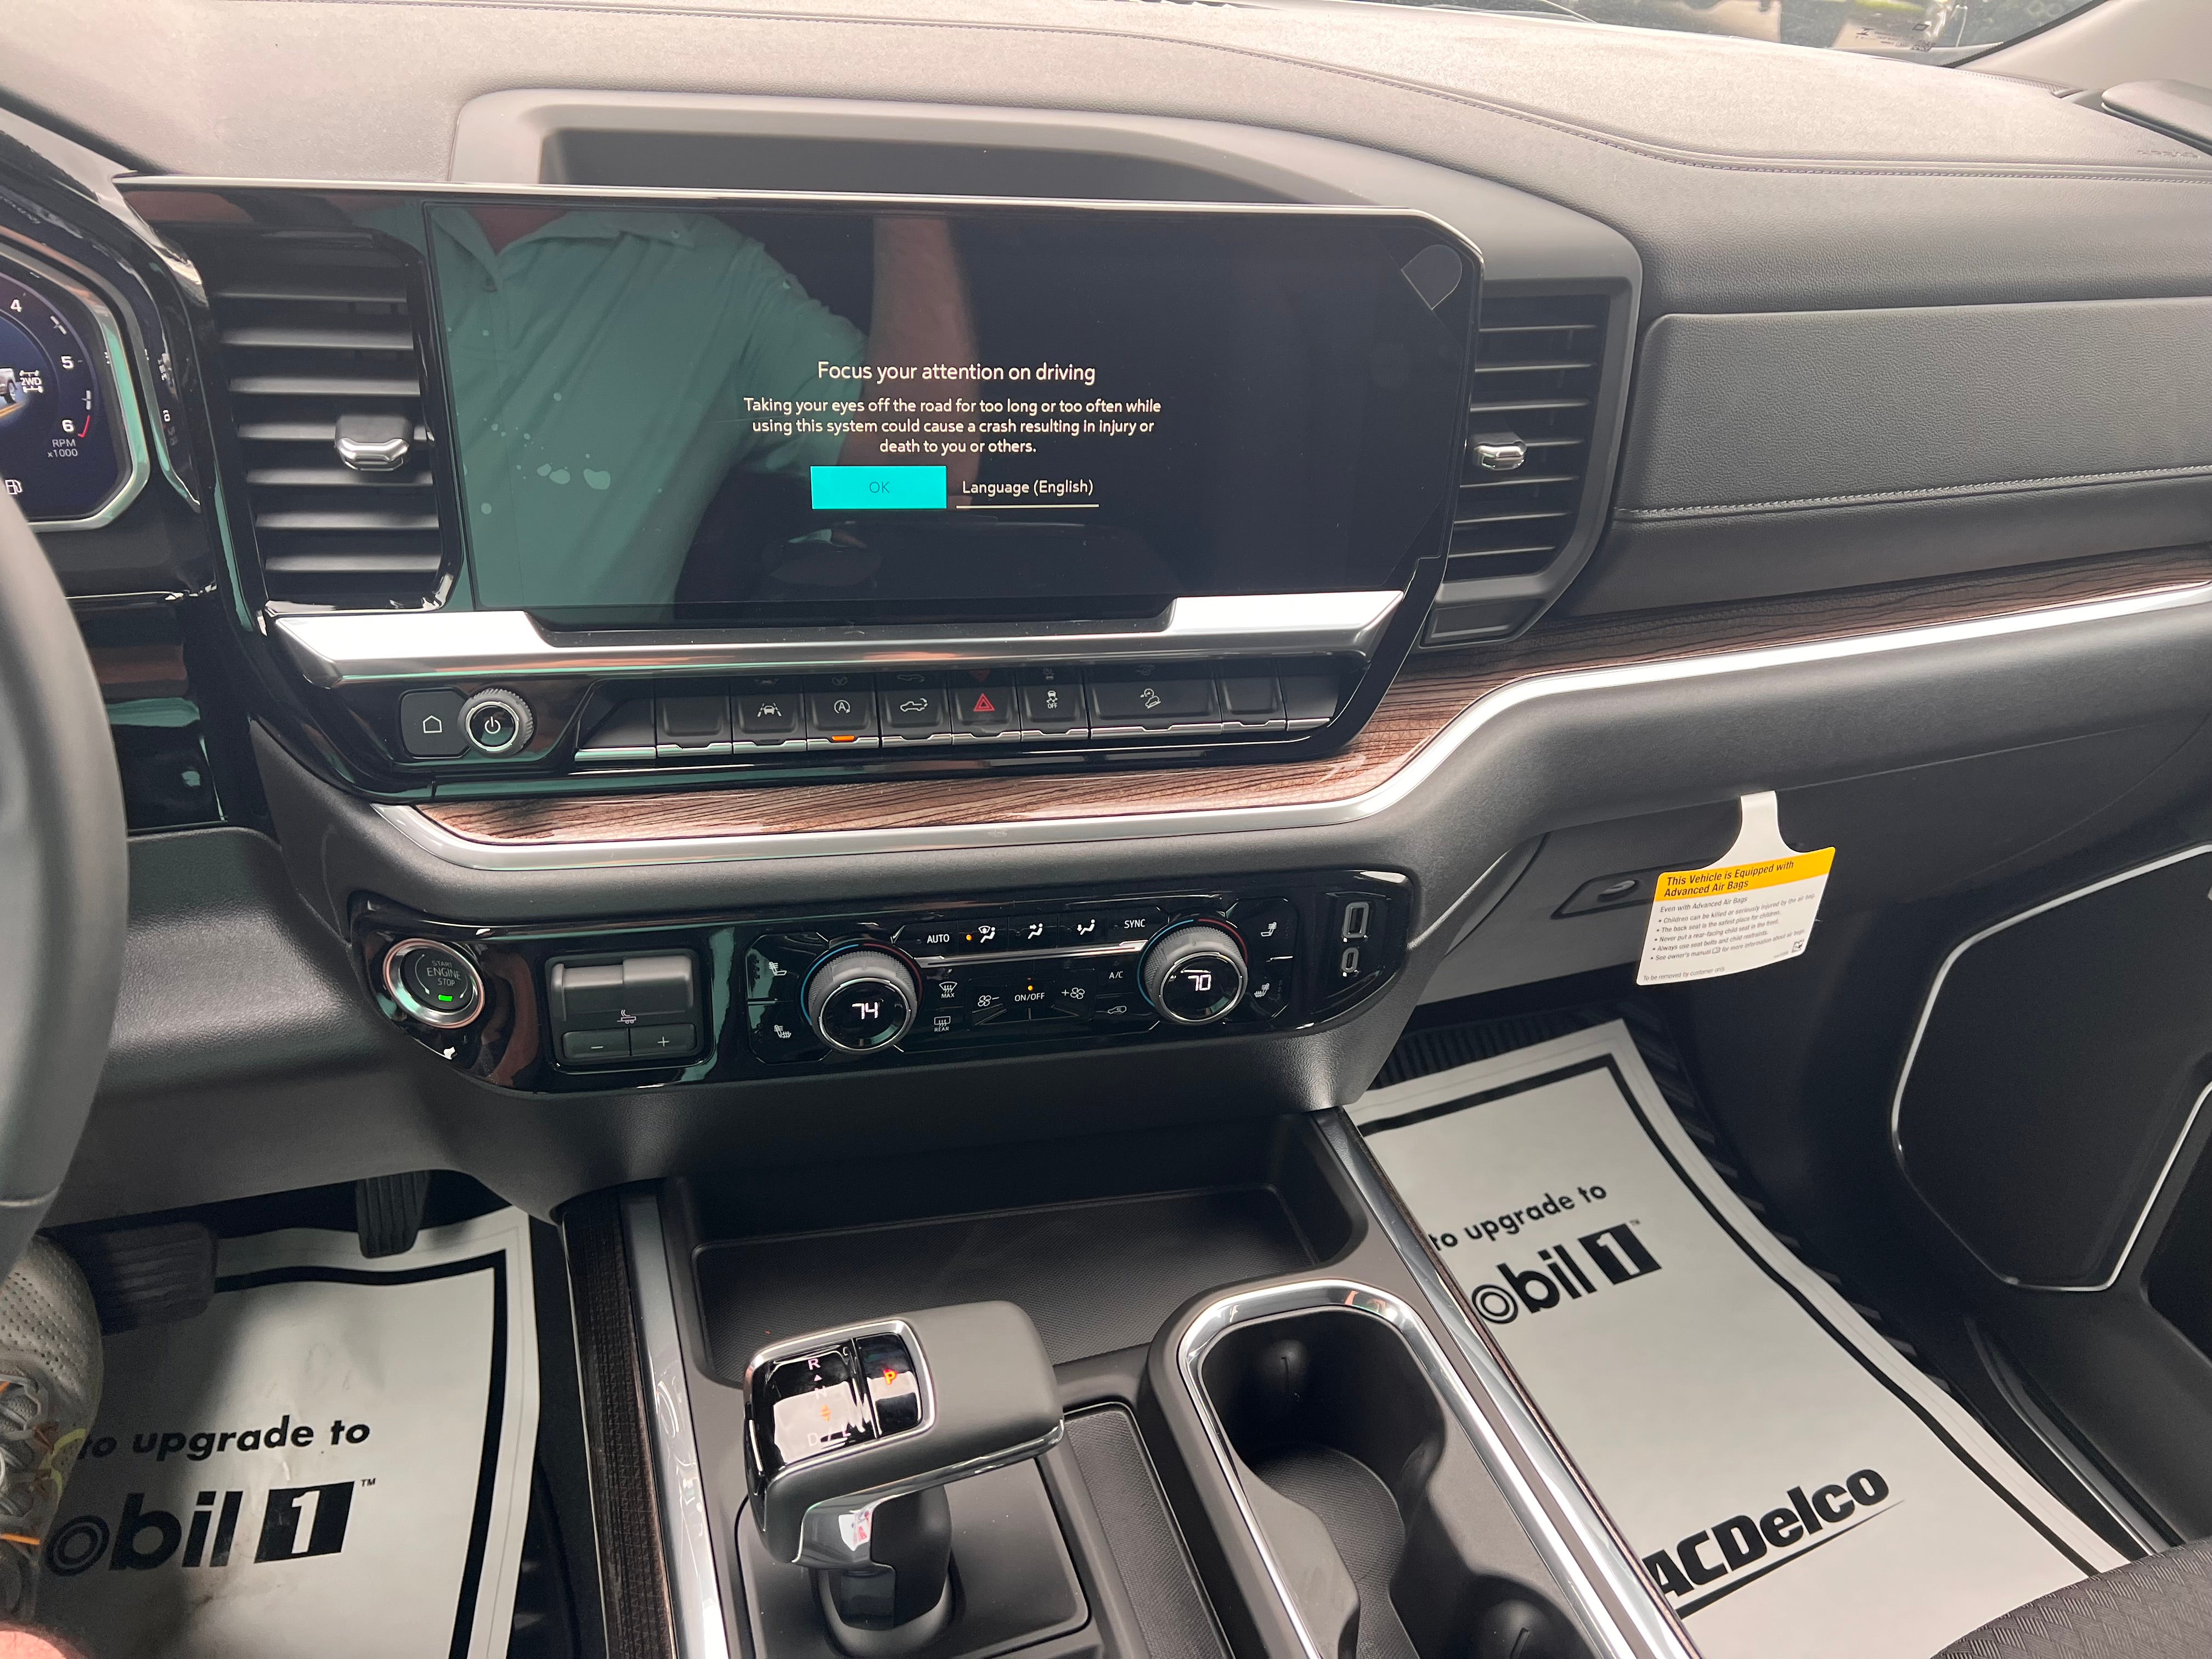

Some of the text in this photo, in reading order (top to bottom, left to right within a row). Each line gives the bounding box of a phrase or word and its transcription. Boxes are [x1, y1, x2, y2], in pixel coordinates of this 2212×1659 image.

[10, 299, 22, 312] 4
[61, 356, 74, 369] 5
[817, 361, 1096, 386] Focus your attention on driving
[20, 377, 42, 386] 2WD
[743, 397, 1162, 416] Taking your eyes off the road for too long or too often while
[62, 419, 74, 432] 6
[752, 418, 1154, 437] using this system could cause a crash resulting in injury or
[52, 439, 76, 447] RPM
[880, 438, 1036, 456] death to you or others.
[47, 448, 78, 458] x1000
[869, 481, 890, 493] OK
[962, 478, 1093, 497] Language (English)
[1667, 860, 1795, 885] This Vehicle is Equipped with
[1664, 880, 1749, 897] Advanced Air Bags
[1692, 901, 1722, 910] Advanced
[1735, 906, 1760, 915] seriously
[1761, 901, 1780, 910] injured
[1759, 910, 1781, 919] children.
[1124, 919, 1146, 929] SYNC
[927, 934, 950, 944] AUTO
[1693, 929, 1724, 939] rear-facing
[1744, 938, 1772, 949] information
[1773, 933, 1786, 941] about
[432, 960, 453, 968] START
[427, 967, 461, 981] ENGINE
[1109, 970, 1124, 979] A/C
[1690, 968, 1714, 976] customer
[437, 978, 455, 986] STOP
[1187, 974, 1211, 991] 70
[1014, 992, 1045, 1002] ON/OFF
[852, 1002, 878, 1020] 74
[1428, 1185, 1607, 1251] to upgrade to
[1471, 1244, 1598, 1325] obil
[808, 1358, 821, 1370] R
[883, 1369, 898, 1385] P
[133, 1415, 314, 1462] upgrade
[330, 1419, 371, 1446] to
[45, 1491, 244, 1577] obil
[360, 1477, 377, 1487] TM
[1641, 1468, 1890, 1597] ACDelco
